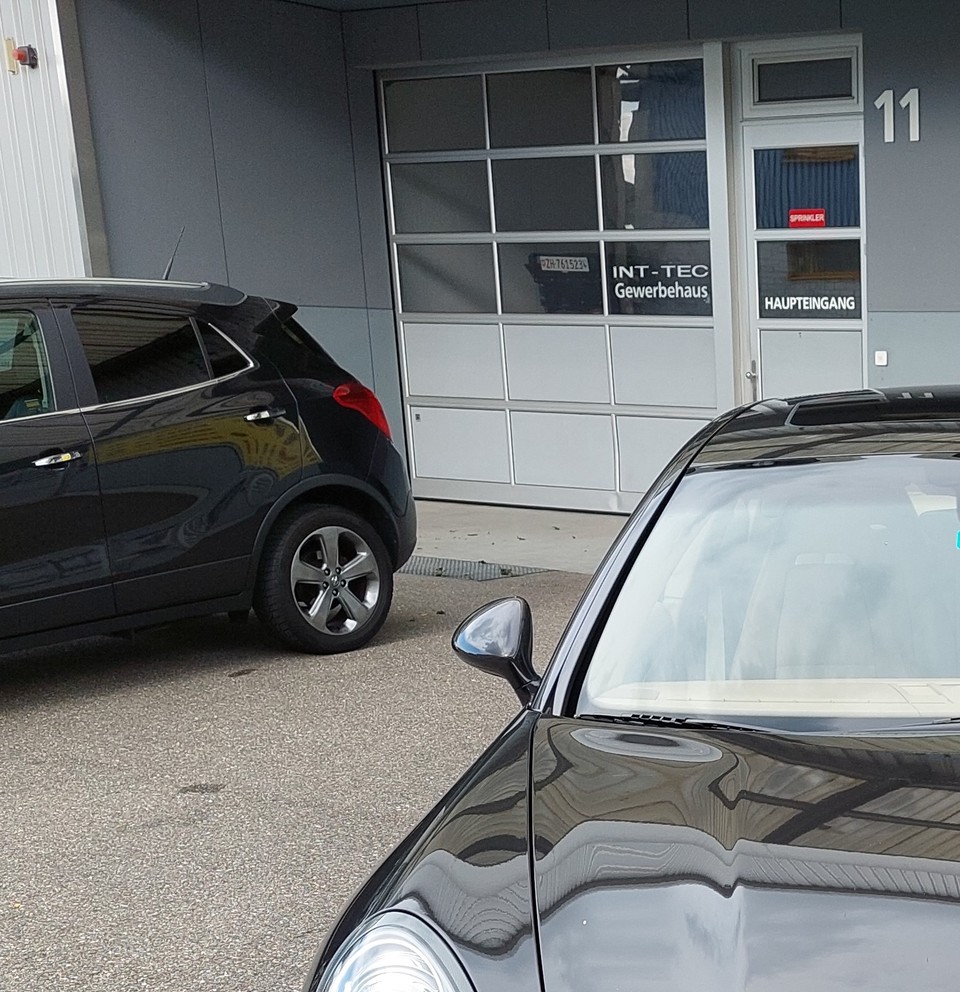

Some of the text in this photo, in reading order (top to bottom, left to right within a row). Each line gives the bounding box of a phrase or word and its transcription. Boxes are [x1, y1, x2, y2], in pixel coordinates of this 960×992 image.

[873, 88, 920, 143] 11
[789, 213, 825, 223] SPRINKLER
[614, 281, 708, 299] Gewerbehaus
[764, 296, 856, 310] HAUPTEINGANG
